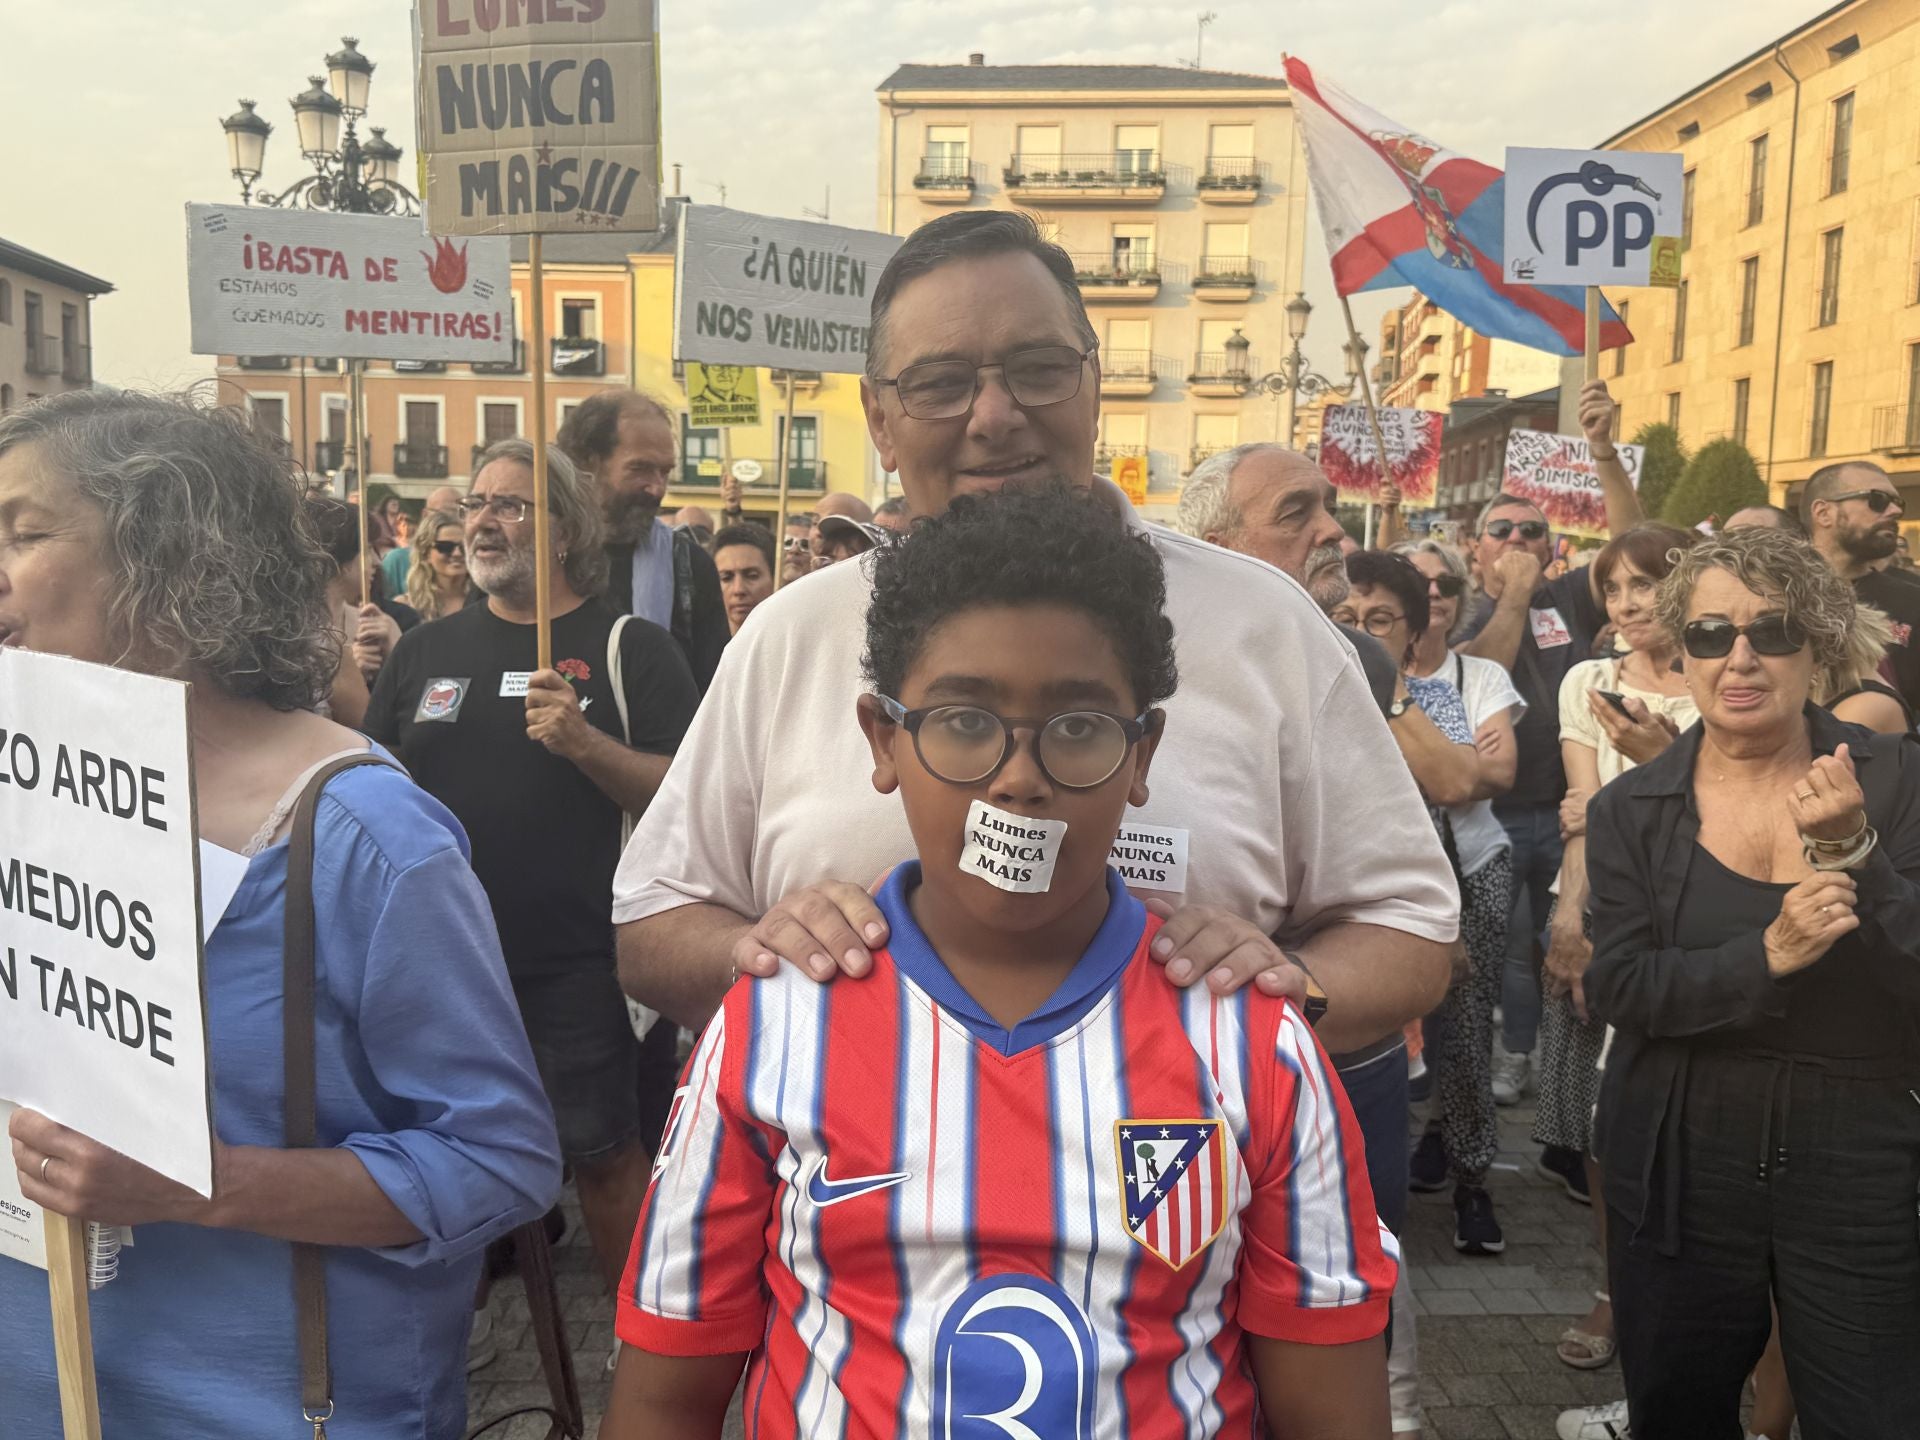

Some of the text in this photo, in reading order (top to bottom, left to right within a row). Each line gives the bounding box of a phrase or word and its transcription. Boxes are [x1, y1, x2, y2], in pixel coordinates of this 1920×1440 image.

[437, 58, 615, 135] NUNCA
[243, 233, 399, 283] ¡BASTA DE
[743, 236, 867, 298] ¿A QUIÉN
[219, 278, 298, 297] ESTAMOS
[232, 307, 325, 328] QUEMADOS
[345, 309, 502, 342] MENTIRAS!
[696, 301, 754, 343] NOS
[1331, 406, 1400, 422] MAÑECO
[1535, 467, 1601, 489] DIMISIO
[52, 743, 168, 832] ARDE
[979, 811, 1047, 841] Lumes
[1116, 829, 1173, 846] Lumes
[972, 830, 1045, 861] NUNCA
[1110, 846, 1176, 865] NUNCA
[976, 854, 1033, 882] MAIS
[1118, 865, 1166, 882] MAIS
[30, 954, 175, 1067] TARDE
